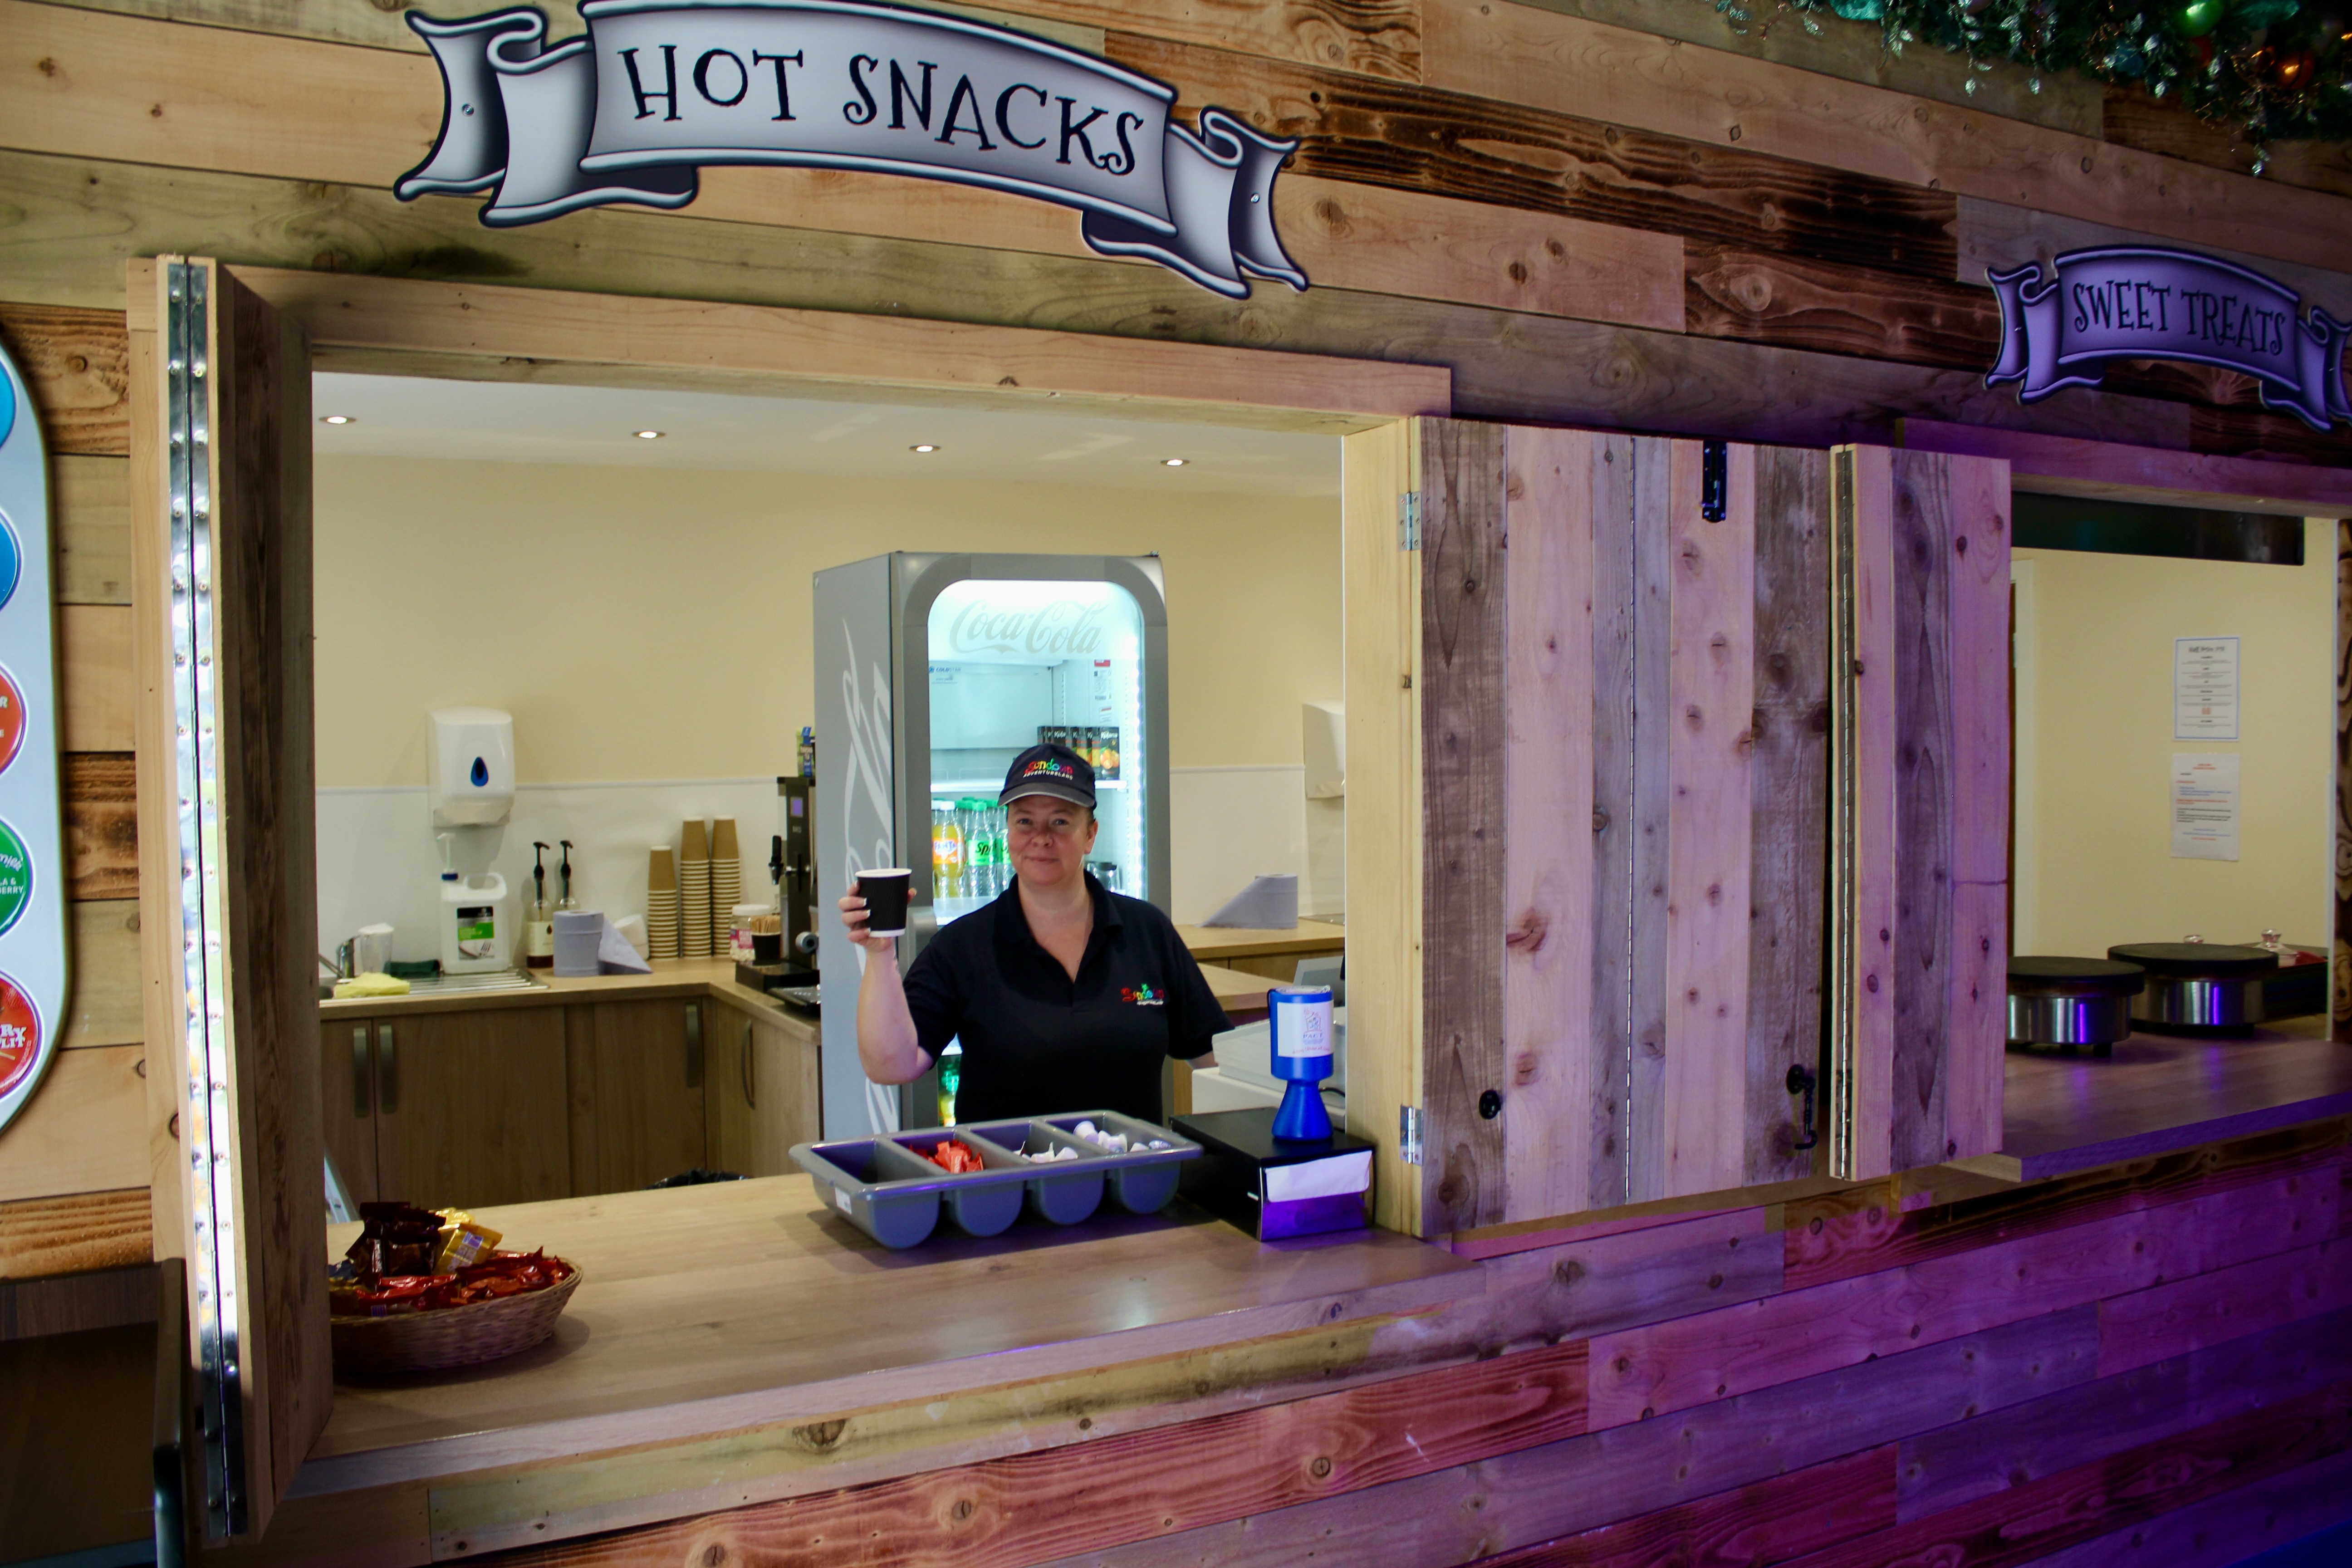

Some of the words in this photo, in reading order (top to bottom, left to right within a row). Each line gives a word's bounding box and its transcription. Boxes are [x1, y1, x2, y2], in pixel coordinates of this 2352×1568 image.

[618, 44, 804, 122] HOT
[842, 53, 1143, 175] SNACKS
[2073, 279, 2170, 332] SWEET
[2181, 288, 2286, 356] TREATS
